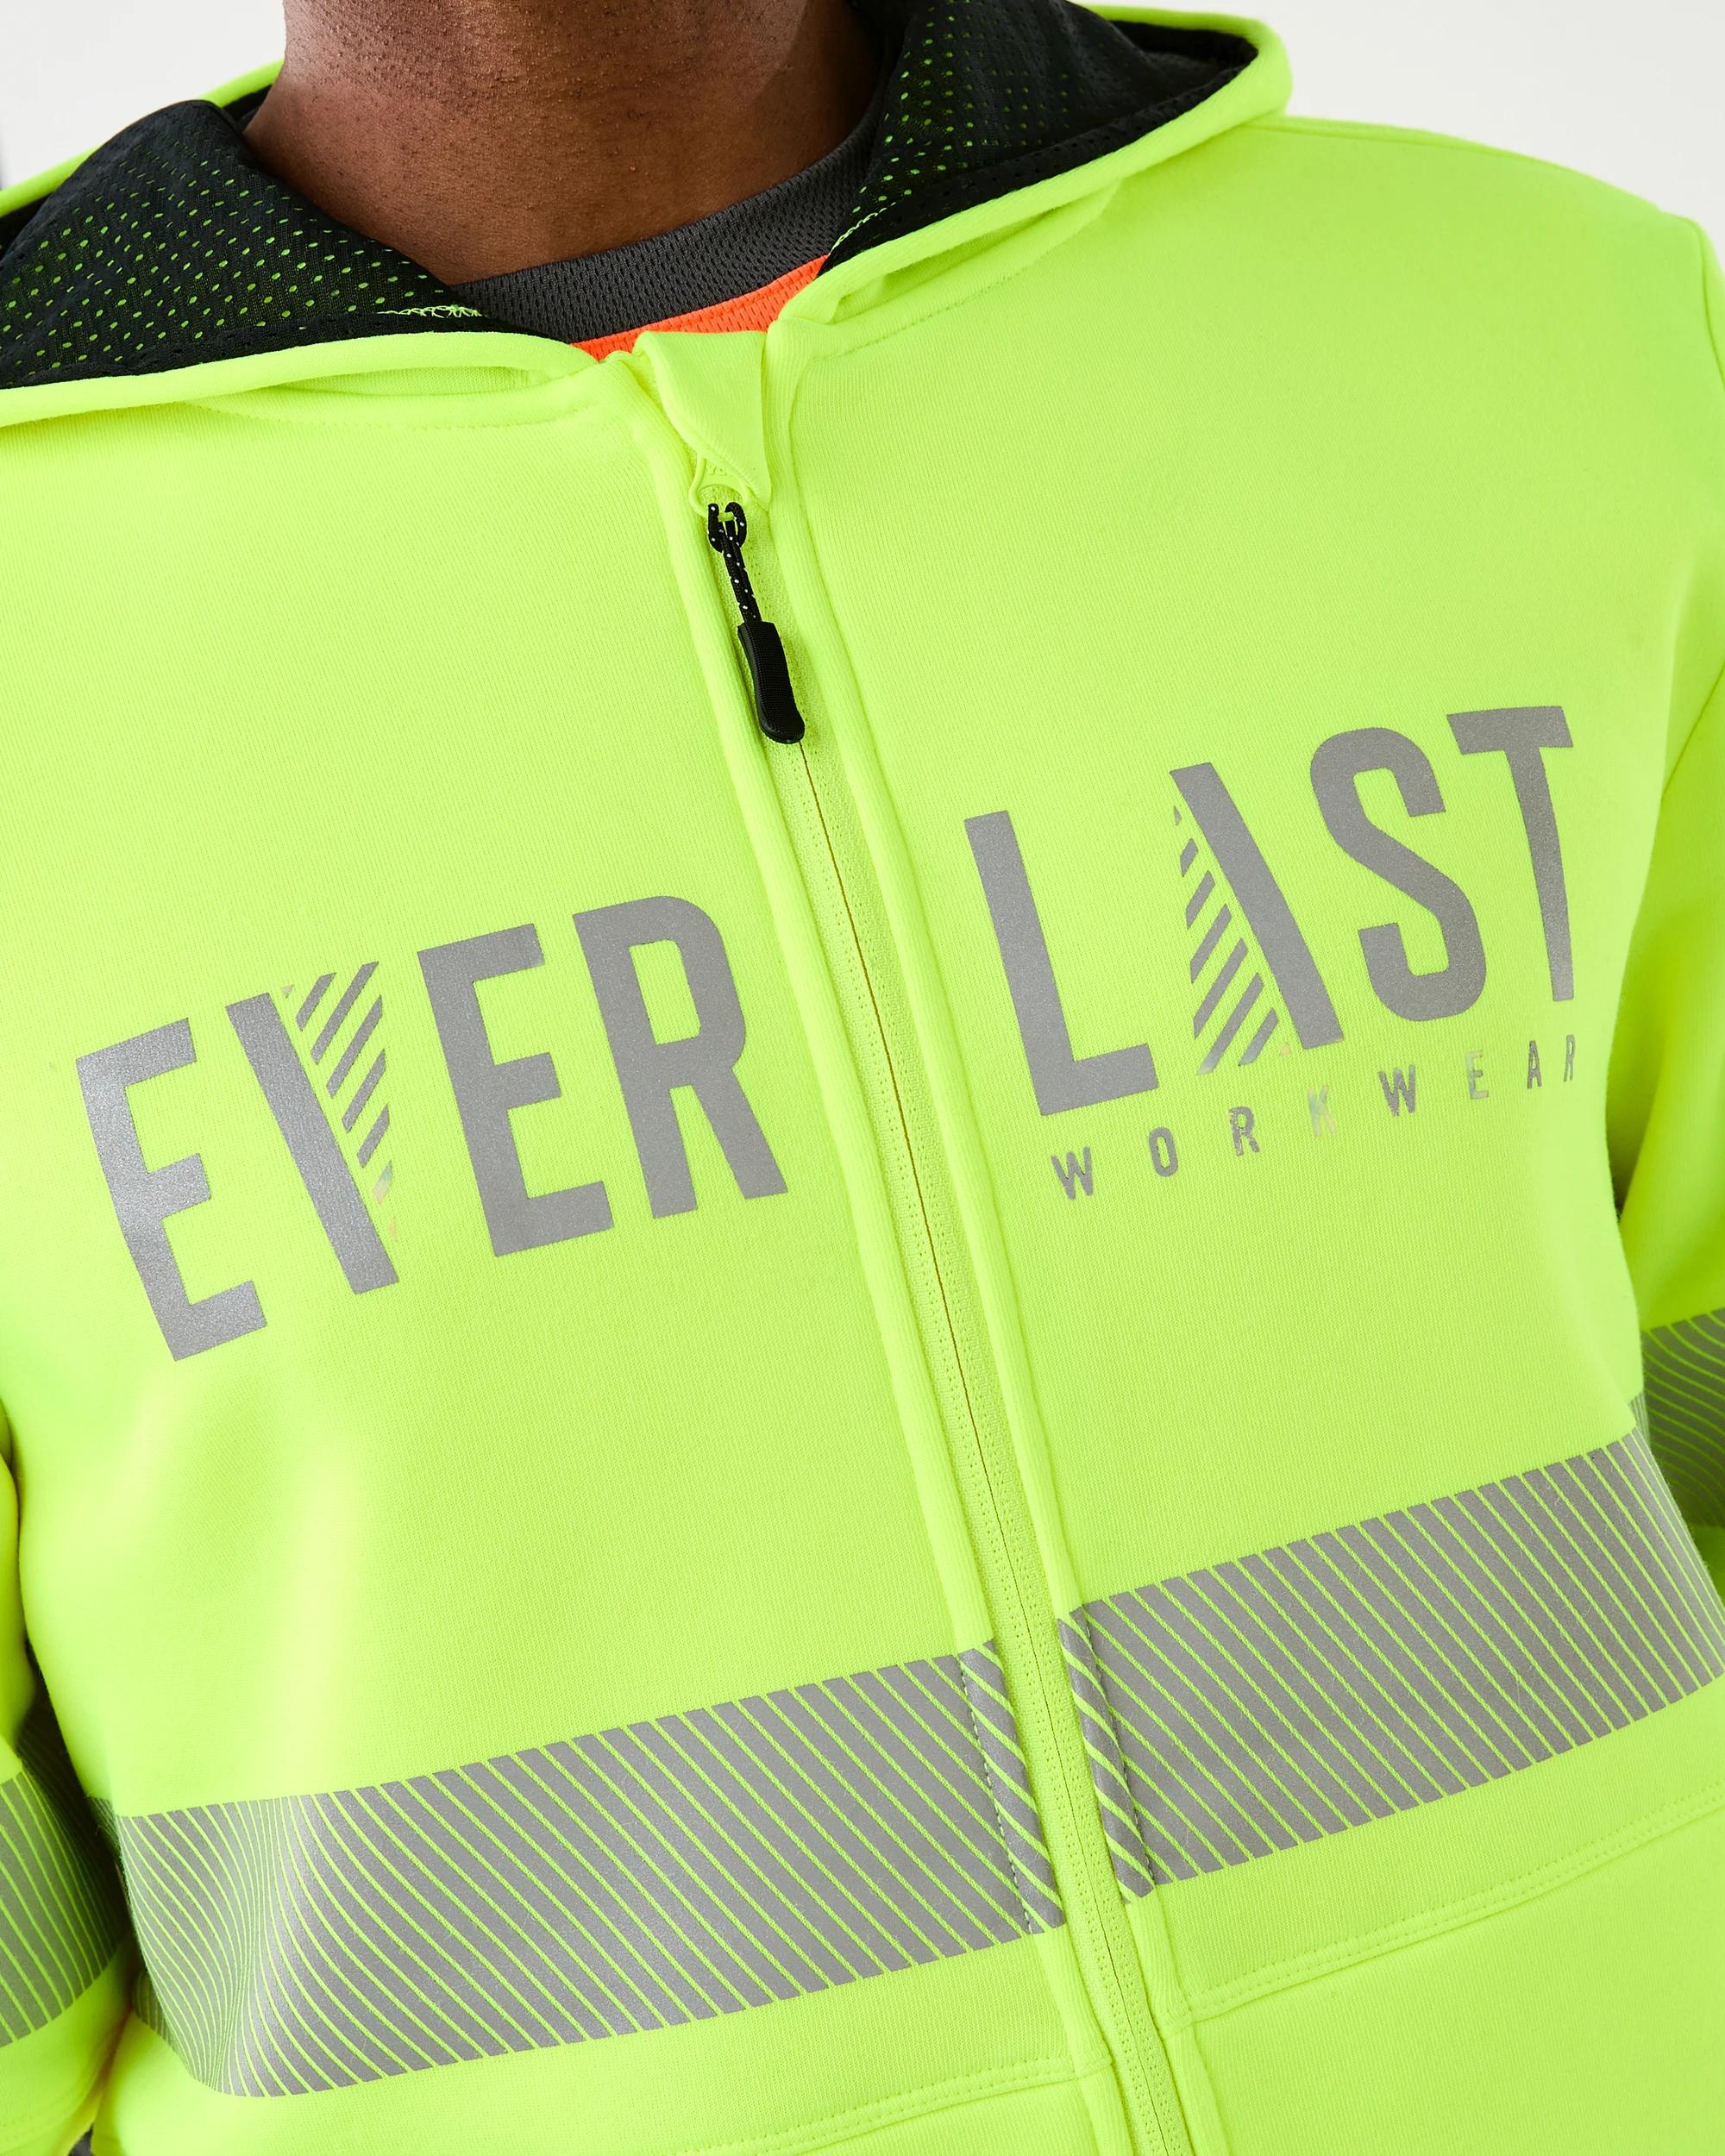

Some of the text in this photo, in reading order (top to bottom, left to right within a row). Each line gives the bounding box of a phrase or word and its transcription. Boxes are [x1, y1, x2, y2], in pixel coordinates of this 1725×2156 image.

[76, 706, 1574, 1361] EVER LAST
[1051, 1034, 1577, 1200] WORKWEAR
